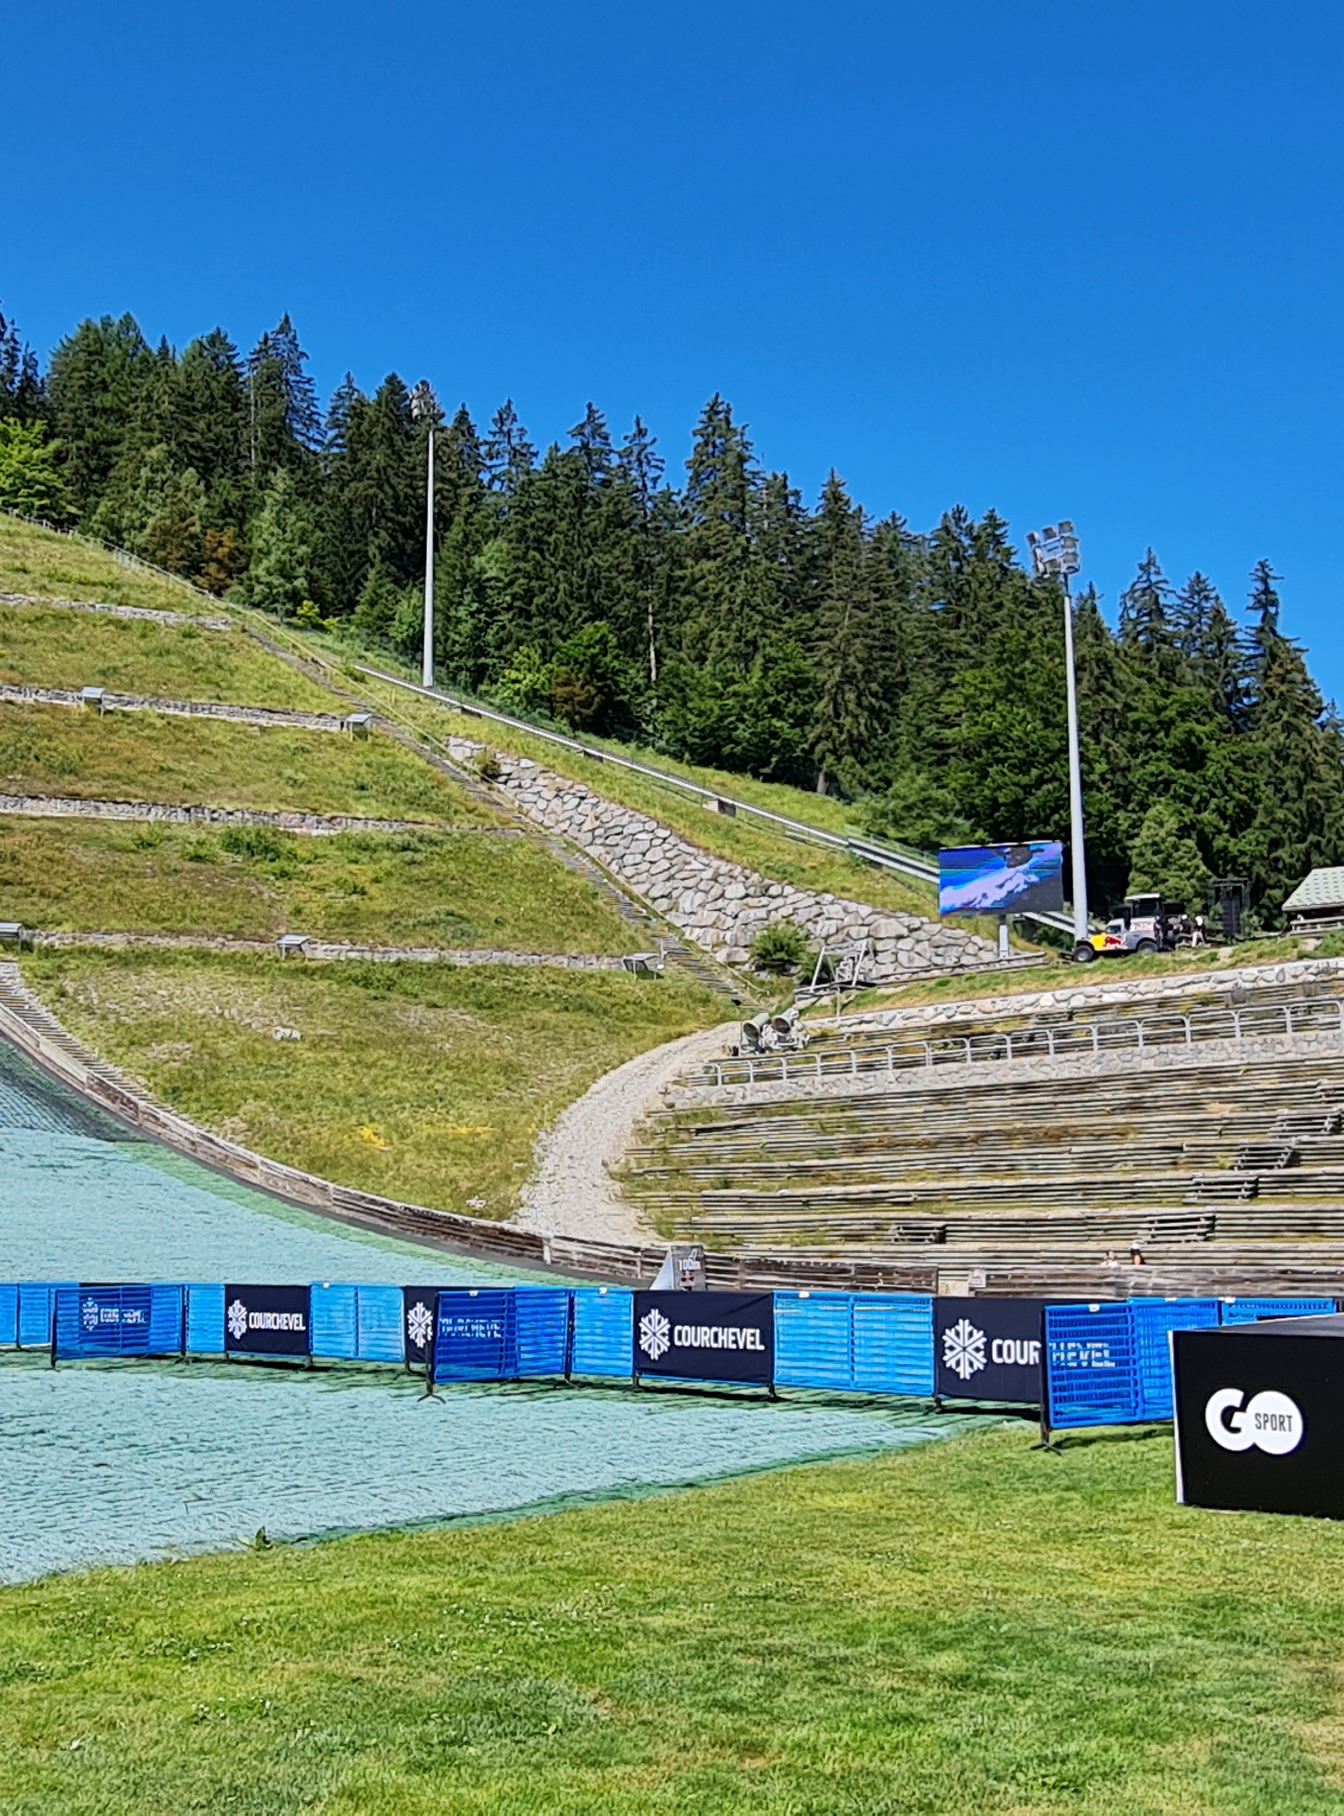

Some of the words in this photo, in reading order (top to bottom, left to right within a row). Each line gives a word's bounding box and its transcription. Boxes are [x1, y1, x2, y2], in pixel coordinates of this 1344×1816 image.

[673, 1325, 766, 1351] COURCHEVEL
[1205, 1388, 1303, 1455] GO
[1254, 1412, 1293, 1433] SPORT
